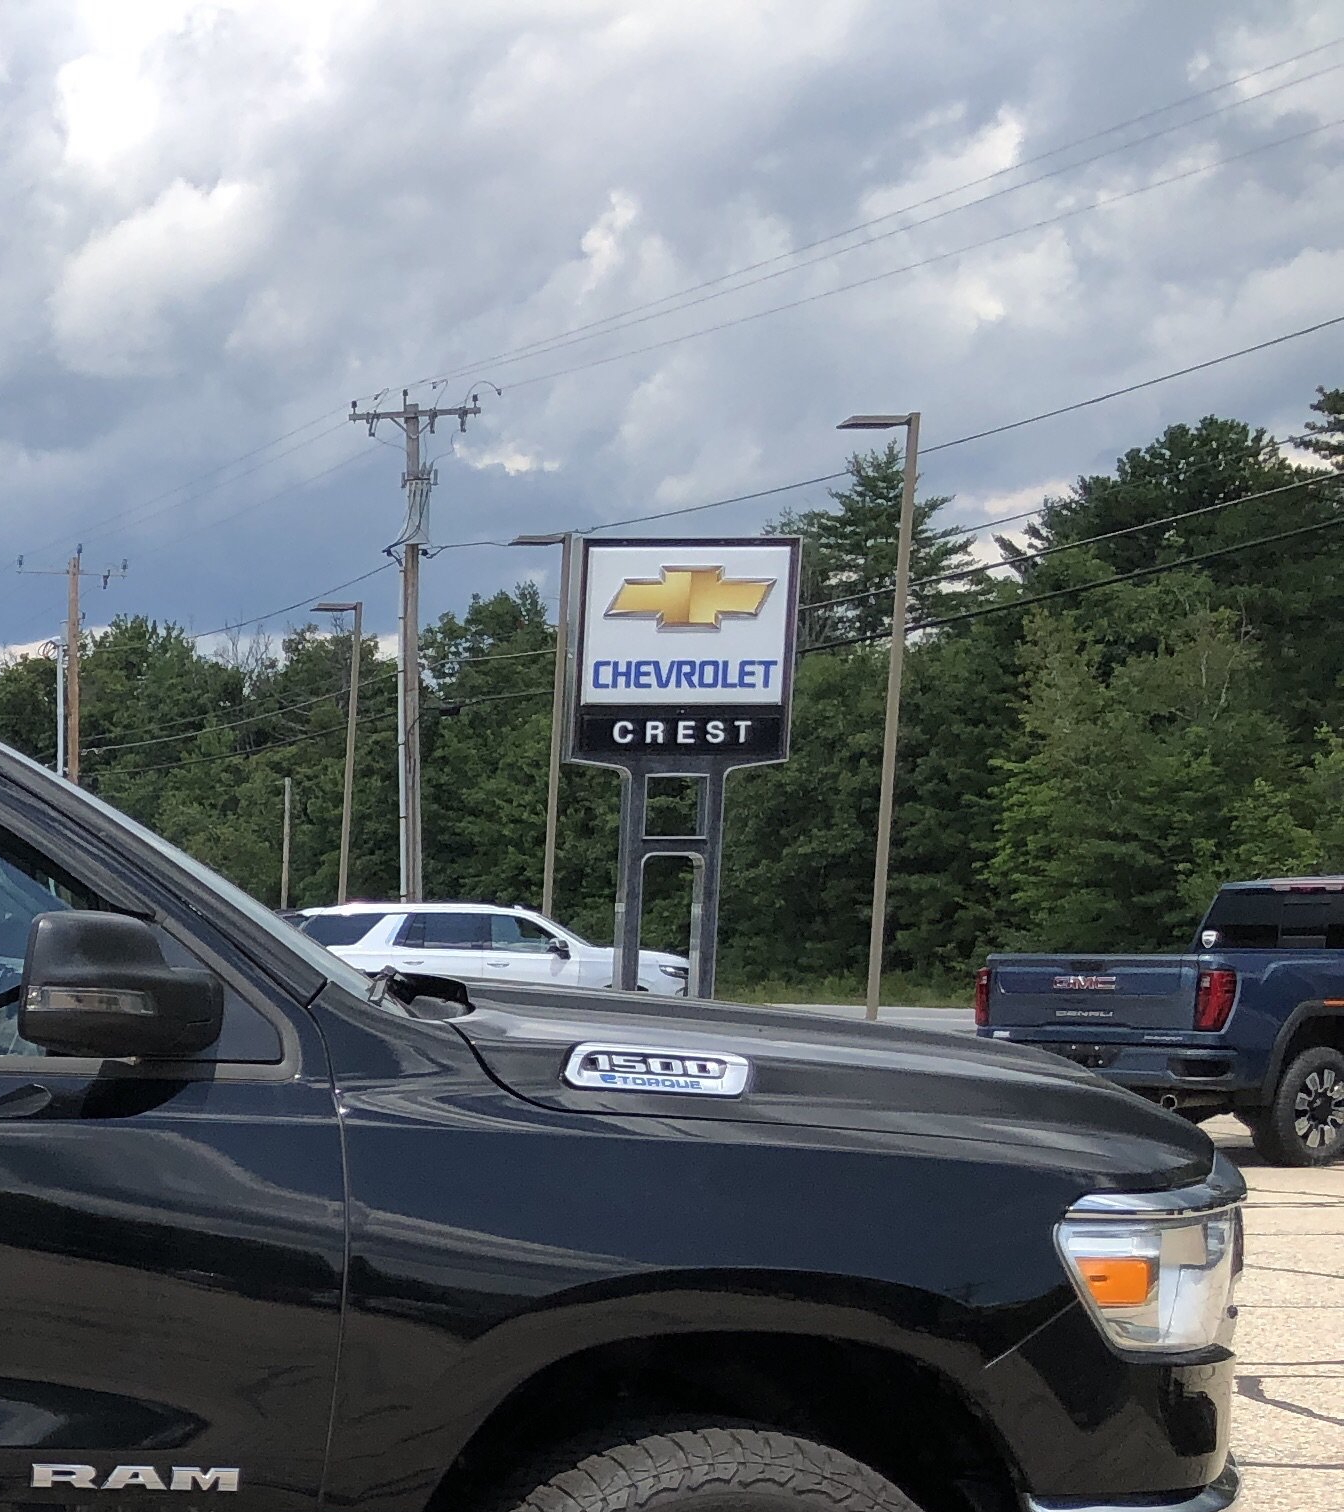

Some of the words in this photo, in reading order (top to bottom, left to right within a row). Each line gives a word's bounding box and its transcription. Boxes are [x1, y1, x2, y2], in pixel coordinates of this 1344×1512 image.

[592, 659, 778, 689] CHEVROLET
[612, 720, 752, 744] CREST
[1054, 976, 1116, 990] GMC
[587, 1054, 720, 1075] 1500
[30, 1463, 240, 1492] RAM
